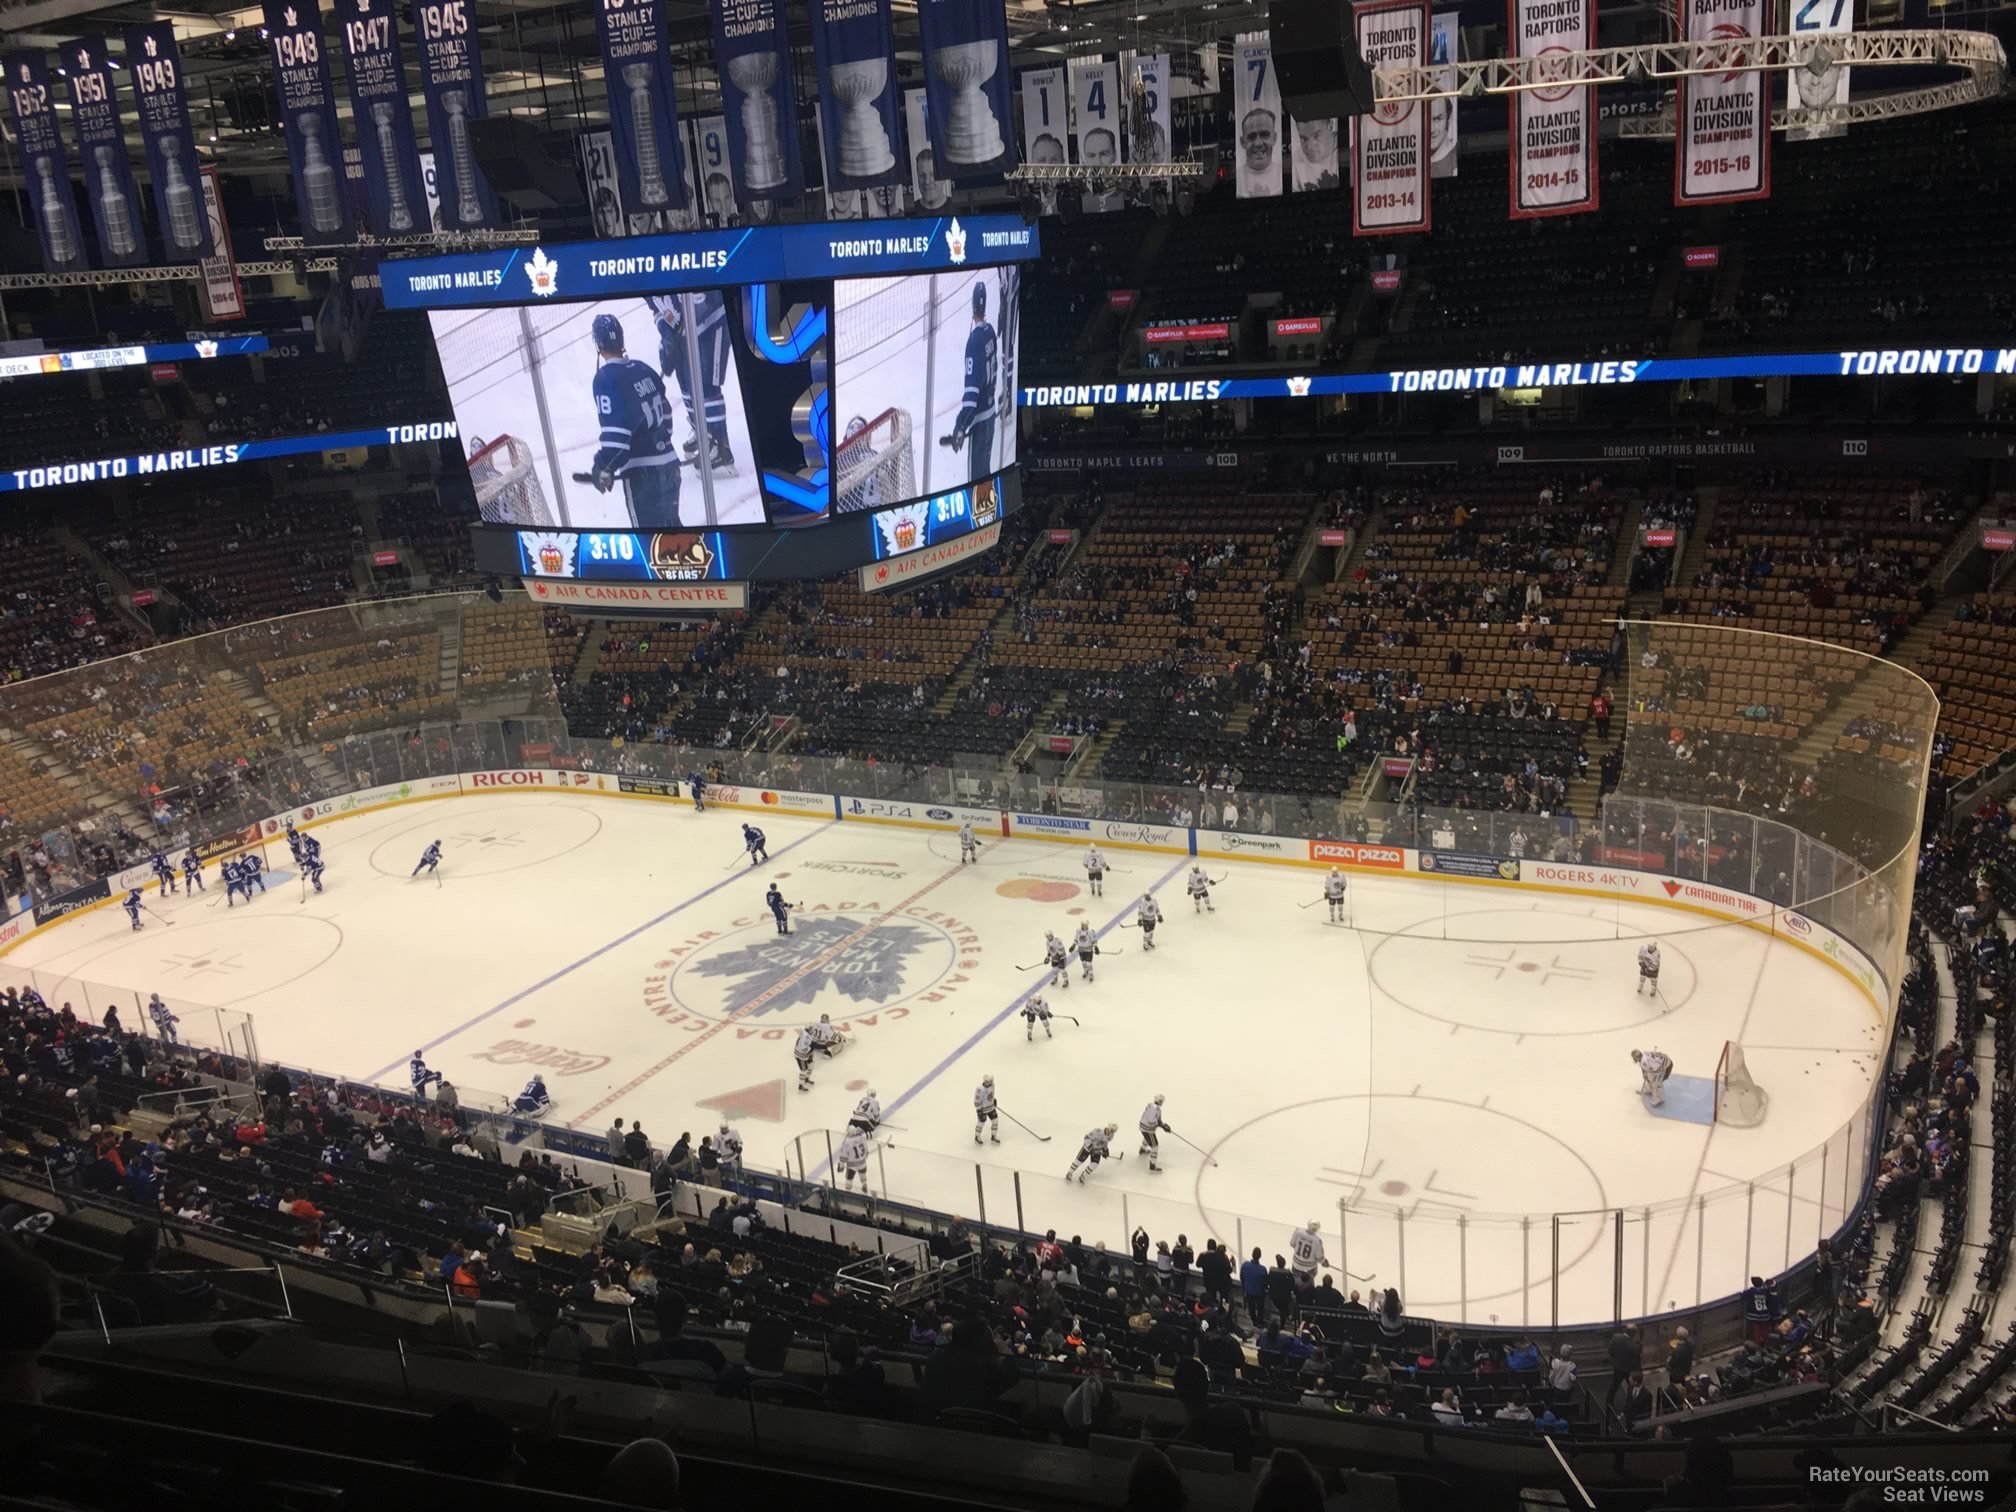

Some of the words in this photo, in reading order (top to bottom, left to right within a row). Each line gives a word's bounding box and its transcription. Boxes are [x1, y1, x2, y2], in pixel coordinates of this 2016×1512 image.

[736, 4, 758, 21] CUP
[824, 3, 877, 22] CHAMPIONS
[1526, 1, 1580, 21] TORONTO
[1695, 0, 1756, 14] RAPTORS
[1795, 0, 1846, 31] 27
[420, 1, 468, 40] 1945
[607, 7, 653, 29] STANLEY
[724, 17, 775, 38] CHAMPIONS
[1525, 17, 1580, 38] RAPTORS
[346, 16, 389, 54] 1947
[622, 26, 643, 42] CUP
[1367, 27, 1416, 46] TORONTO
[274, 31, 319, 67] 1948
[427, 39, 467, 58] STANLEY
[611, 40, 658, 58] CHAMPIONS
[1366, 44, 1416, 63] RAPTORS
[353, 53, 393, 72] STANLEY
[440, 57, 459, 70] CUP
[282, 67, 319, 84] STANLEY
[366, 70, 384, 84] CUP
[432, 69, 472, 84] CHAMPIONS
[1248, 60, 1266, 101] 7
[73, 72, 107, 104] 1951
[295, 84, 311, 95] CUP
[358, 82, 398, 98] CHAMPIONS
[1040, 87, 1049, 126] 1
[1087, 80, 1106, 120] 4
[1695, 92, 1753, 113] ATLANTIC
[1527, 110, 1580, 129] ATLANTIC
[1694, 109, 1753, 131] DIVISION
[1367, 135, 1416, 152] ATLANTIC
[1527, 127, 1580, 147] DIVISION
[1694, 128, 1752, 144] CHAMPIONS
[706, 132, 721, 167] 9
[1527, 143, 1580, 159] CHAMPIONS
[1367, 151, 1416, 169] DIVISION
[1694, 155, 1750, 175] 2015-16
[1367, 167, 1416, 181] CHAMPIONS
[1527, 169, 1578, 189] 2014-15
[1367, 193, 1414, 209] 2013-14
[830, 240, 882, 258] TORONTO
[887, 236, 929, 255] MARLIES
[982, 232, 1008, 247] TORONTO
[1010, 230, 1029, 245] MARLIES
[590, 256, 654, 277] TORONTO
[661, 250, 727, 271] MARLIES
[409, 274, 451, 292] TORONTO
[455, 270, 502, 288] MARLIES
[82, 351, 111, 361] LOCATED
[112, 350, 122, 359] ON
[123, 349, 136, 357] THE
[1840, 350, 1983, 374] TORONTO
[6, 364, 30, 374] DECK
[1390, 367, 1505, 391] TORONTO
[1517, 361, 1637, 387] MARLIES
[633, 377, 656, 397] SMITH
[1025, 385, 1116, 406] TORONTO
[1127, 381, 1220, 402] MARLIES
[387, 421, 457, 444] TORON
[1218, 455, 1236, 464] 108
[1341, 453, 1359, 463] THE
[1363, 452, 1397, 461] NORTH
[1501, 449, 1521, 458] 109
[1604, 447, 1645, 457] TORONTO
[1649, 445, 1692, 456] RAPTORS
[1696, 443, 1755, 454] BASKETBALL
[14, 458, 127, 489] TORONTO
[138, 445, 238, 474] MARLIES
[1037, 458, 1082, 468] TORONTO
[1087, 457, 1121, 467] MAPLE
[1130, 457, 1163, 466] LEAFS
[937, 491, 964, 522] 3:10
[589, 535, 633, 560] 3:10
[896, 561, 916, 574] AIR
[922, 544, 964, 566] CANADA
[968, 528, 996, 549] CENTRE
[666, 571, 698, 580] BEARS
[556, 586, 579, 597] AIR
[585, 587, 649, 600] CANADA
[659, 589, 727, 600] CENTRE
[473, 771, 543, 787] RICOH
[317, 803, 332, 815] LG
[870, 803, 912, 818] PS4
[280, 815, 293, 828] LG
[1022, 816, 1062, 827] TORONTO
[1063, 820, 1086, 829] STAR
[1106, 823, 1136, 842] Crown
[1134, 828, 1172, 844] Royal
[1238, 839, 1280, 850] Greenpark
[1314, 845, 1355, 858] pizza
[1357, 847, 1400, 863] pizza
[1092, 858, 1097, 867] 2
[1536, 867, 1594, 882] ROGERS
[1600, 873, 1618, 885] 4K
[1621, 875, 1639, 888] TV
[1685, 886, 1736, 910] CANADIAN
[1737, 899, 1758, 913] TIRE
[670, 930, 721, 955] AIR
[907, 906, 981, 953] CENTRE
[918, 973, 970, 1004] AIR
[644, 975, 709, 1032] CENTRE
[853, 1144, 865, 1159] 13
[1296, 1241, 1312, 1259] 18
